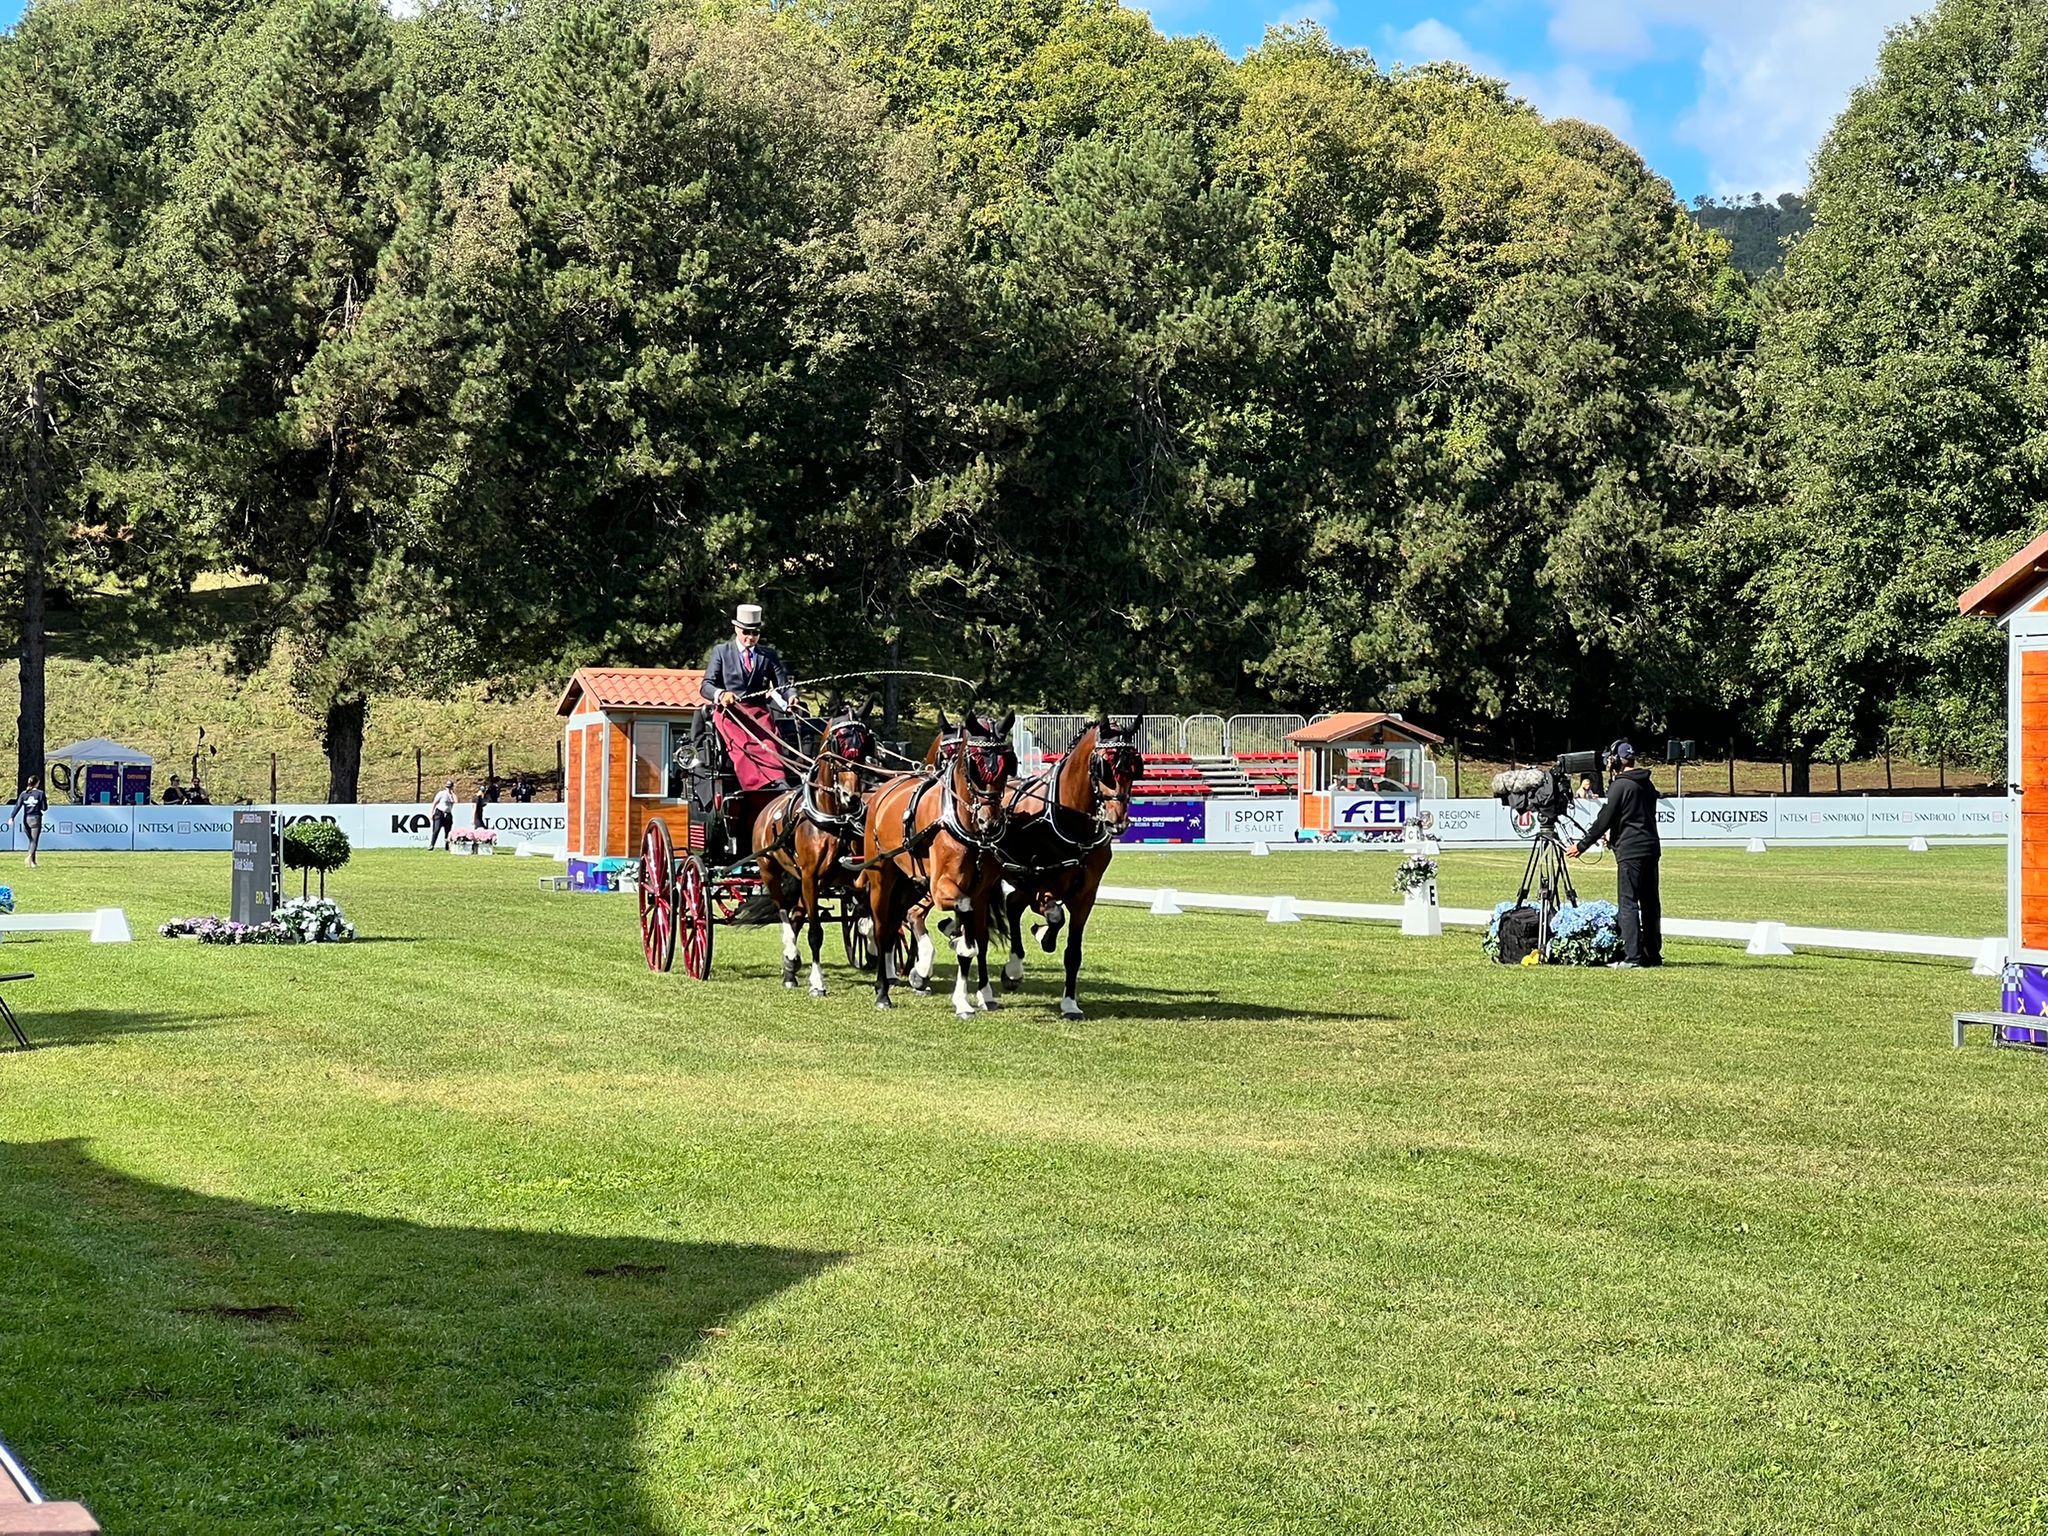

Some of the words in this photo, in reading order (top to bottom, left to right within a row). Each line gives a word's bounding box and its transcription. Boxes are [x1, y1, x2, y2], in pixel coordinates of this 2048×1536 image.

[1234, 811, 1284, 822] SPORT
[1341, 800, 1406, 823] FEI
[1438, 811, 1481, 820] REGIONE
[1691, 810, 1769, 823] LONGINES
[1780, 813, 1808, 822] INTESA
[1822, 813, 1865, 822] SANPAOLO
[1871, 812, 1899, 822] INTESA
[1914, 812, 1956, 822] SANPAOLO
[1962, 812, 1990, 822] INTESA
[75, 823, 129, 833] SANPAOLO
[138, 823, 174, 833] INTESA
[193, 823, 233, 833] SANPAO
[484, 817, 566, 831] LONGINE
[1234, 824, 1240, 832] E
[1244, 824, 1284, 833] SALUTE
[1438, 820, 1468, 830] LAZIO
[1429, 885, 1436, 906] E
